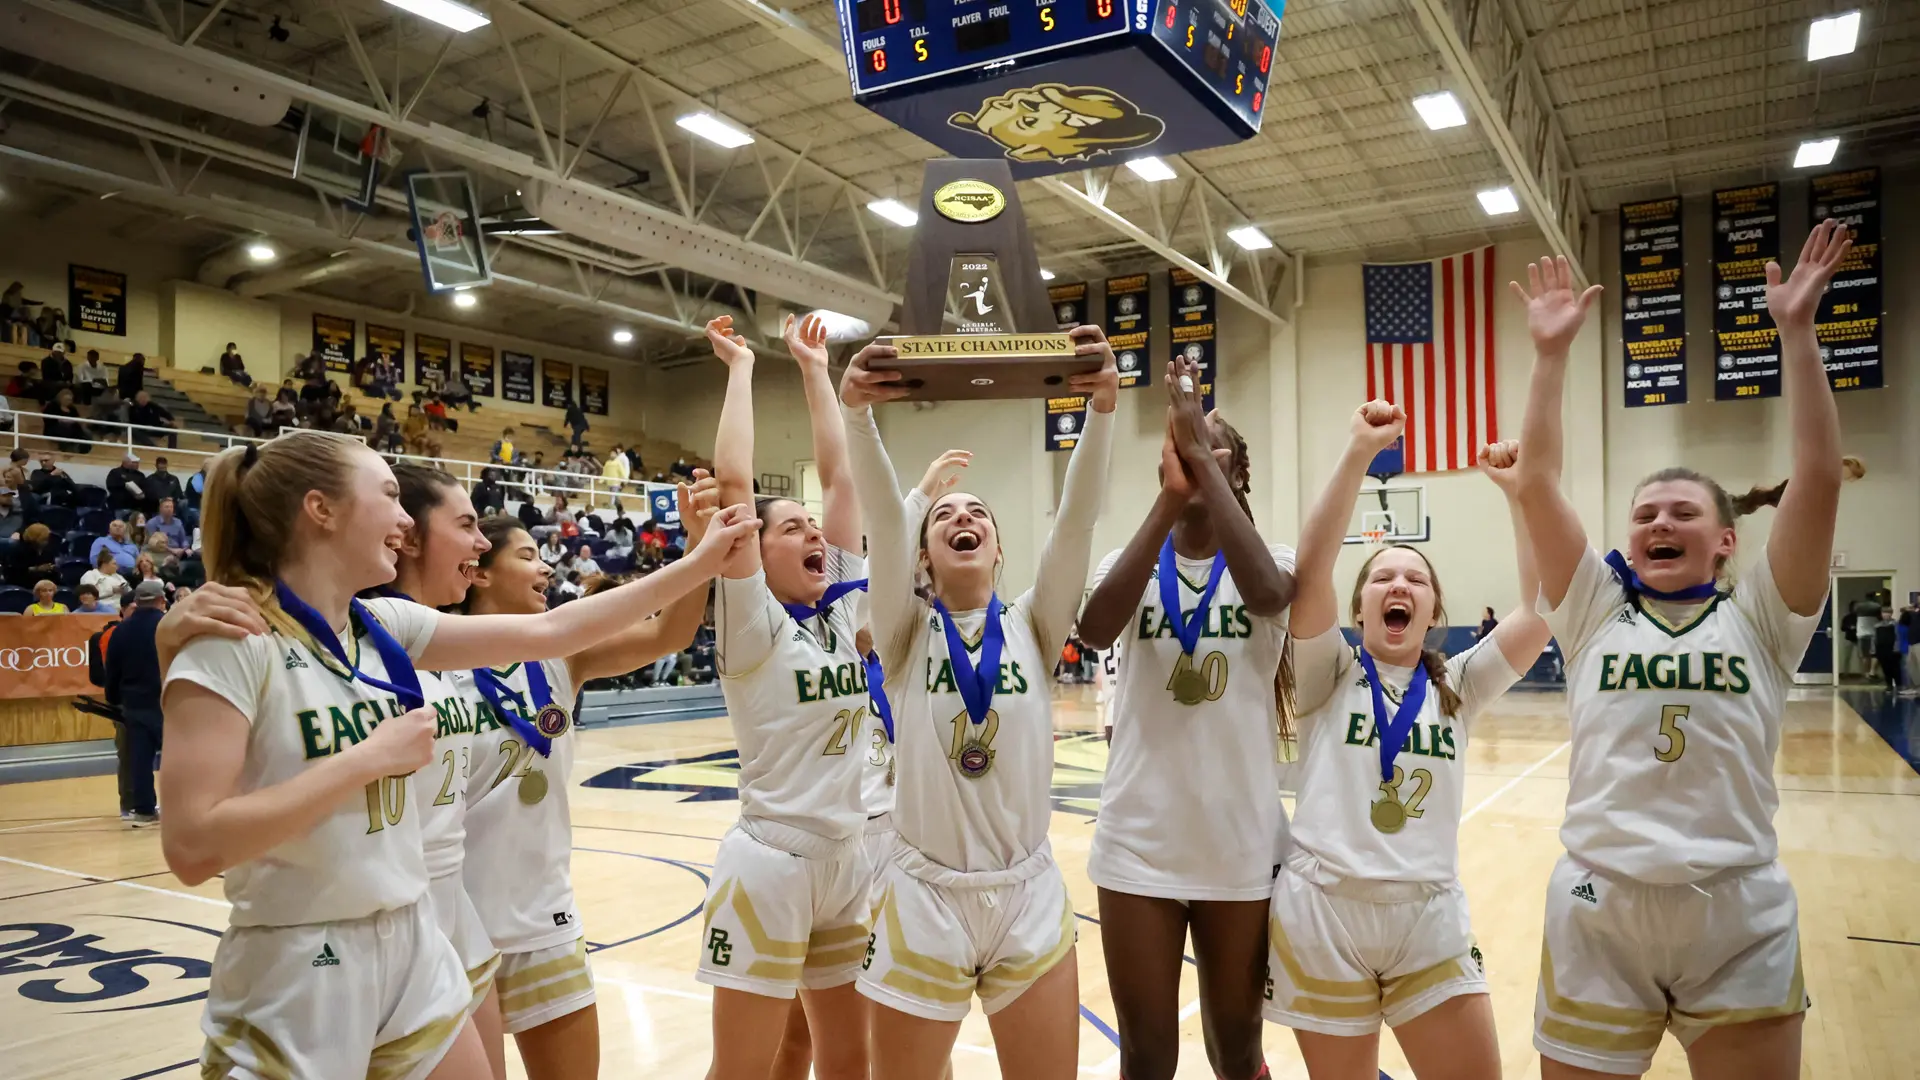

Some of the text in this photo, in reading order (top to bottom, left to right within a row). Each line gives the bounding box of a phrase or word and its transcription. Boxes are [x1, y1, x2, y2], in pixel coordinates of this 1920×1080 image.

[952, 5, 1010, 27] PLAYER FOUL
[1040, 7, 1055, 31] 5
[909, 26, 929, 39] T.O.L.
[1185, 25, 1195, 47] 5
[862, 36, 886, 50] FOULS
[914, 39, 928, 62] 5
[873, 49, 887, 72] 0
[1259, 45, 1271, 73] 0
[1235, 73, 1244, 94] 5
[1728, 228, 1763, 242] NCAA
[1624, 242, 1649, 252] NCAA
[1734, 243, 1758, 255] 2012
[962, 263, 988, 271] 2022
[1625, 268, 1680, 282] WINGATE
[1833, 277, 1877, 289] CHAMPION
[1642, 294, 1682, 305] CHAMPION
[1718, 301, 1745, 310] NCAA
[1832, 303, 1858, 314] 2014
[1625, 311, 1650, 320] NCAA
[1735, 314, 1760, 325] 2012
[1718, 328, 1777, 341] WINGATE
[1720, 336, 1775, 345] UNIVERSITY
[902, 338, 1067, 354] STATE CHAMPIONS
[1626, 338, 1683, 351] WINGATE
[1629, 345, 1681, 355] UNIVERSITY
[1834, 345, 1878, 356] CHAMPION
[1736, 355, 1778, 365] CHAMPION
[1644, 363, 1683, 374] CHAMPION
[1824, 363, 1844, 372] CAA
[1718, 371, 1744, 381] NCAA
[1834, 376, 1860, 388] 2014
[1627, 380, 1652, 389] NCAA
[1735, 385, 1760, 396] 2013
[1644, 393, 1665, 403] 2011
[1598, 652, 1752, 694] EAGLES
[795, 660, 869, 703] EAGLE
[1345, 712, 1456, 761] EALES
[1653, 704, 1691, 763] 5
[365, 774, 406, 835] 10
[1571, 888, 1597, 904] adidas
